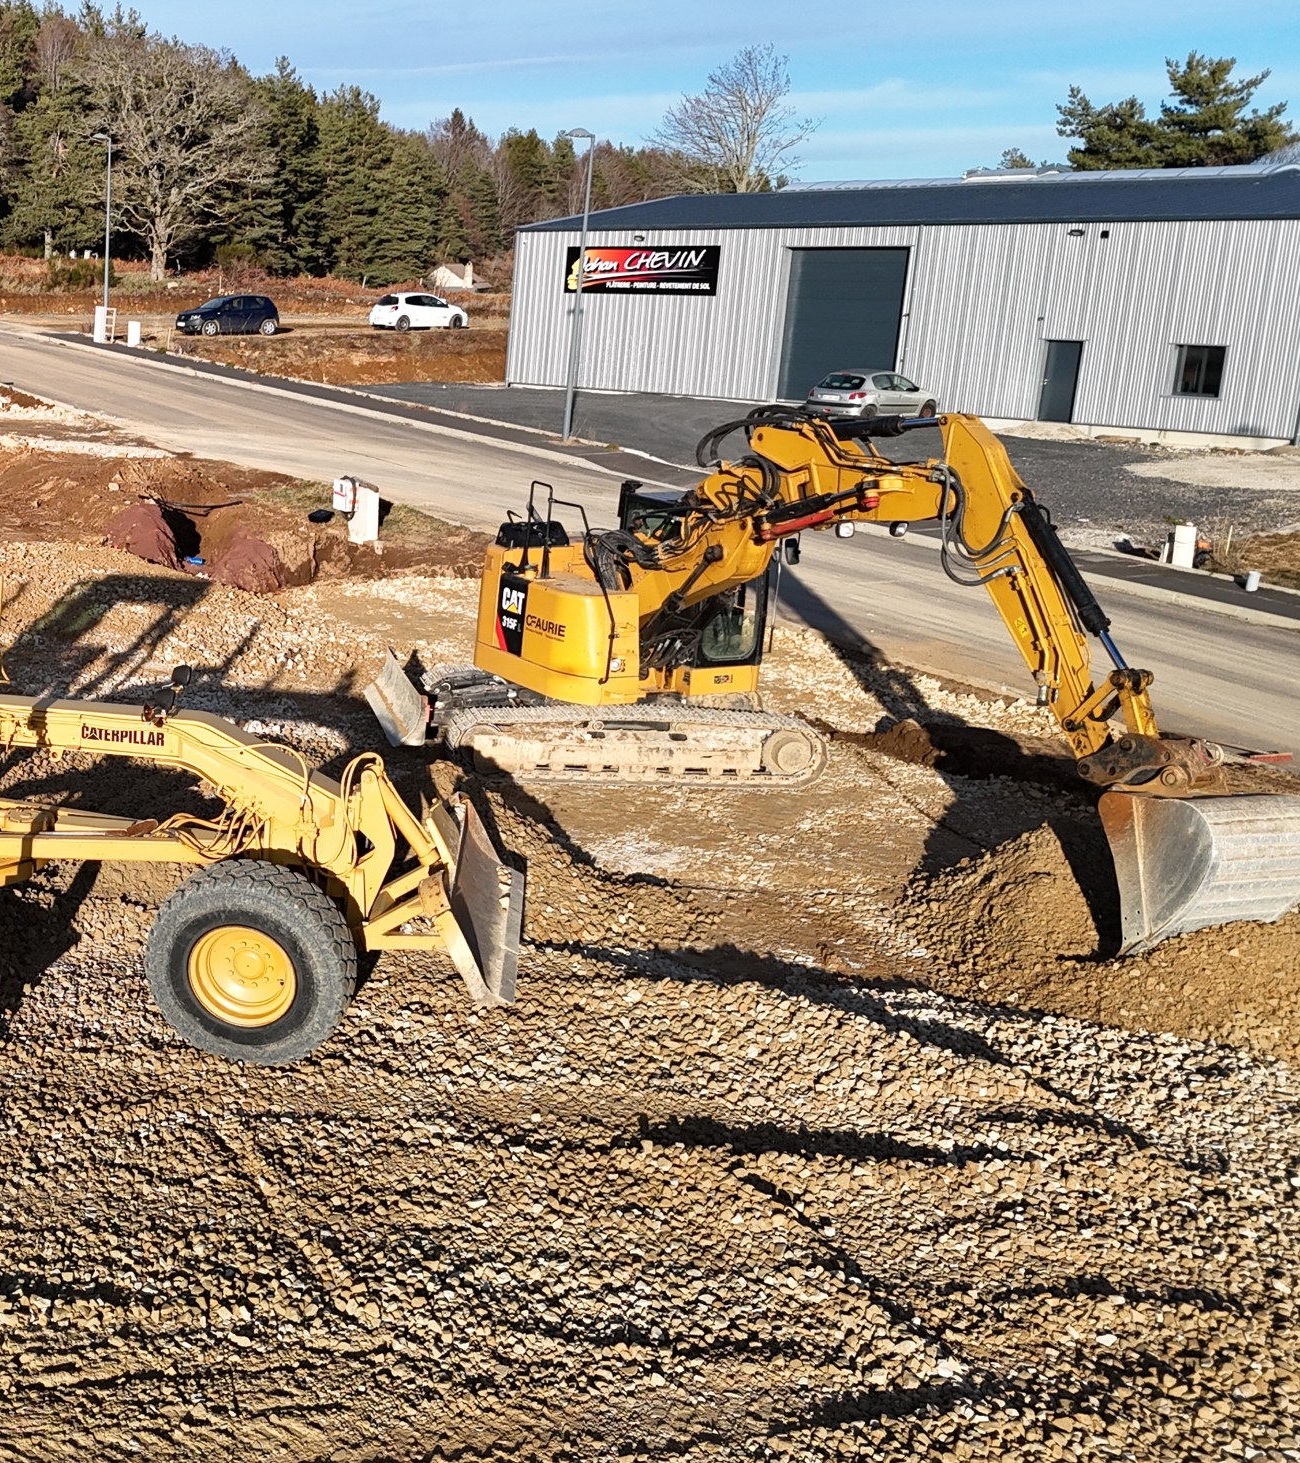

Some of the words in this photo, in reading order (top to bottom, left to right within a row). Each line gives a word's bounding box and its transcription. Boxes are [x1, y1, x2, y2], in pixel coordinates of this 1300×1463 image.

[623, 249, 707, 270] CHEVIN
[699, 282, 711, 290] SOL
[502, 586, 526, 615] CAT
[502, 615, 519, 631] 315F
[81, 724, 166, 747] CATERPILLAR
